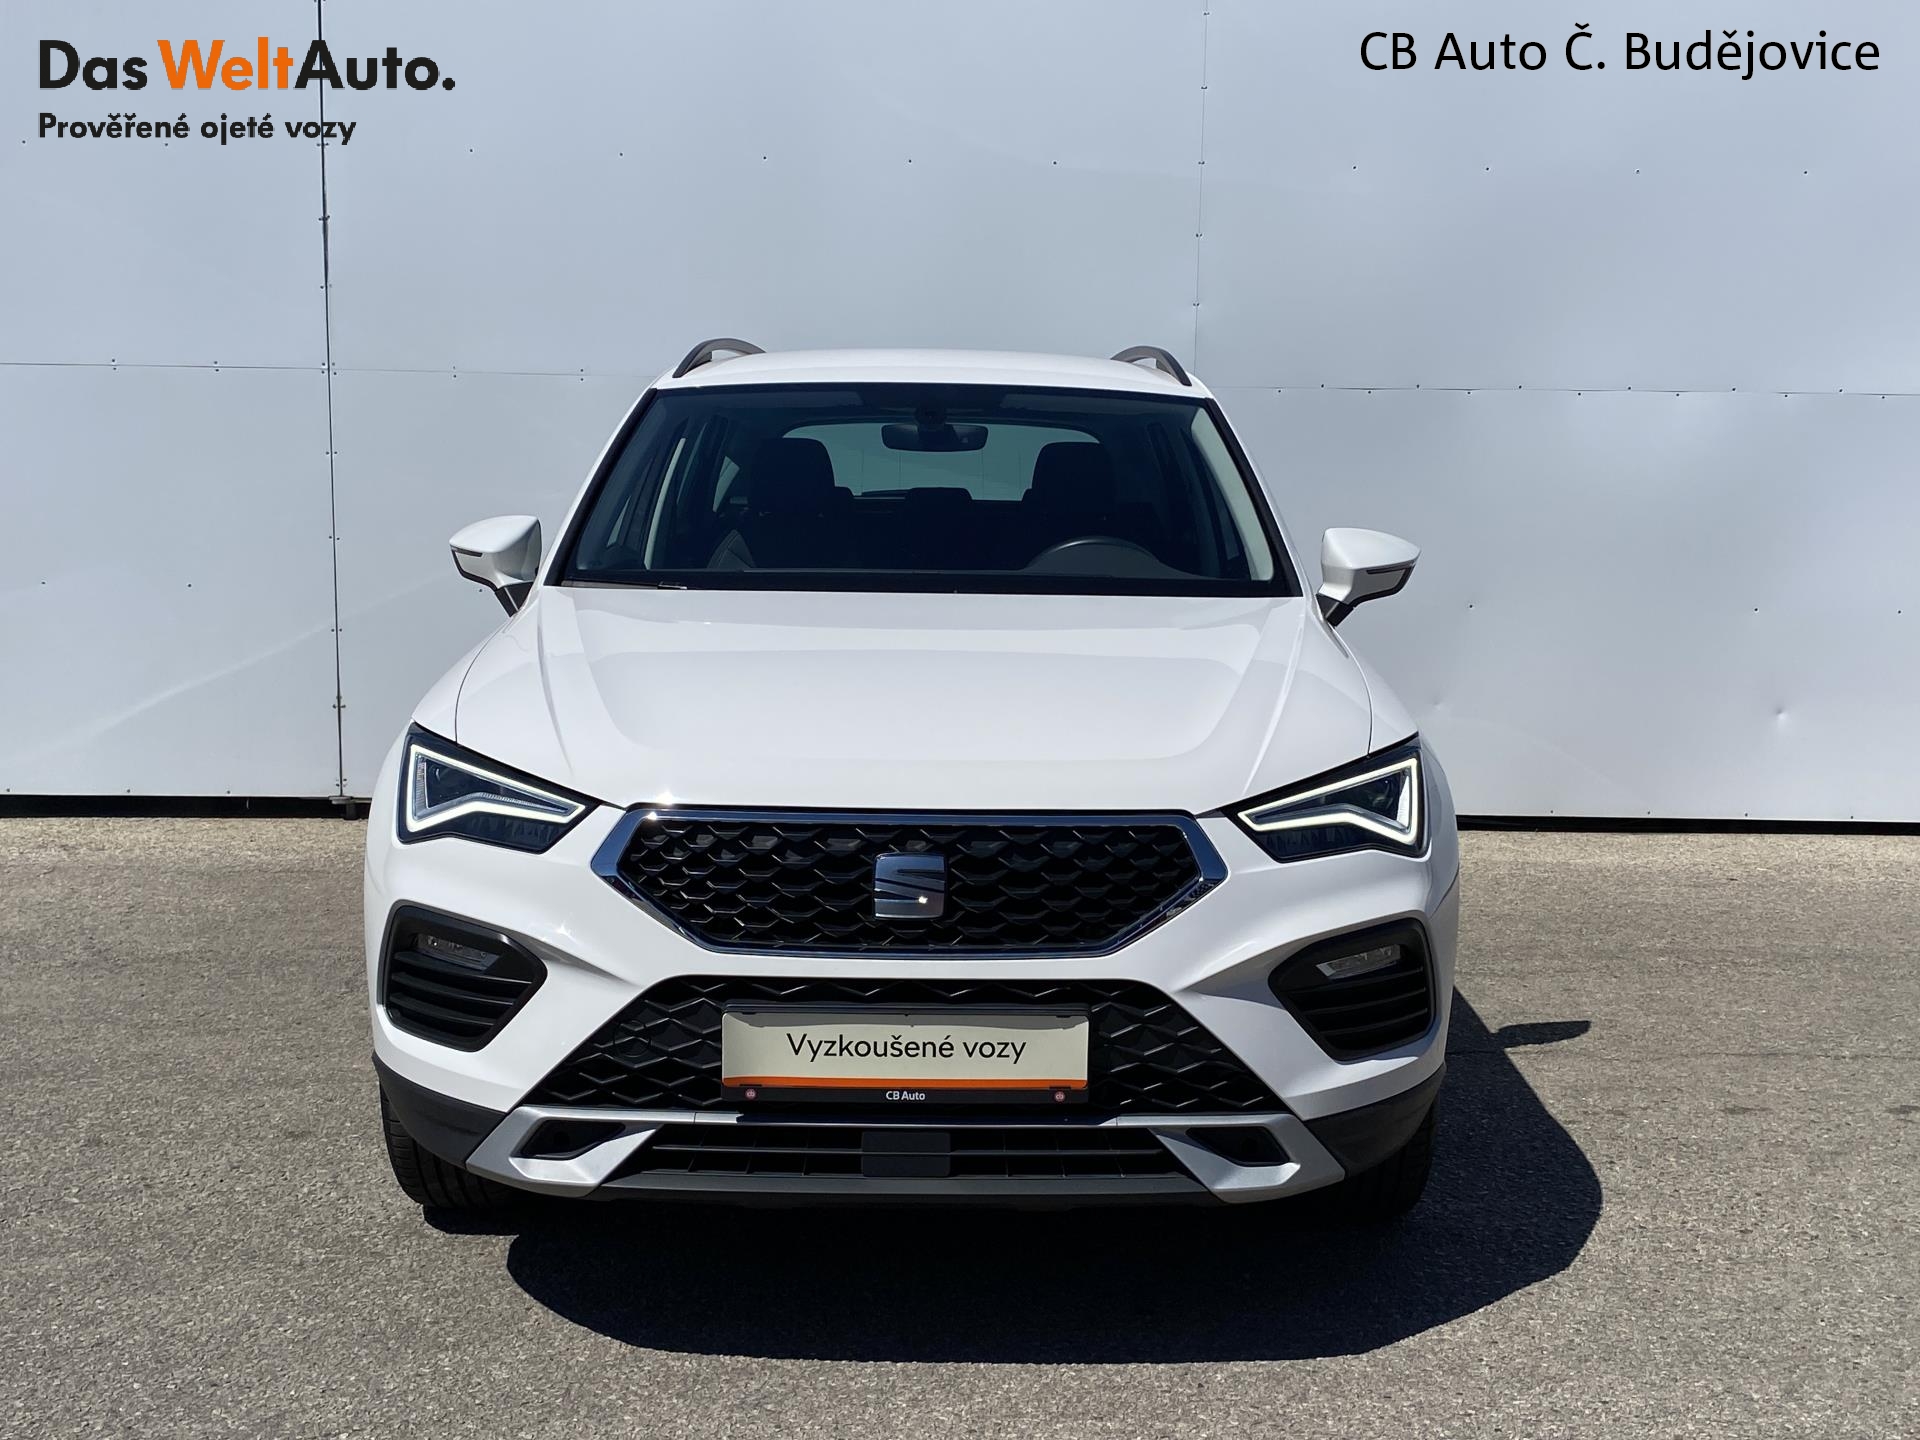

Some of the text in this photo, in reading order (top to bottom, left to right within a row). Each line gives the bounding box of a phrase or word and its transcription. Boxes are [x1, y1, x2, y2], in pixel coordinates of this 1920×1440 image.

[786, 1033, 1027, 1065] Vyzkoušené vozy
[885, 1090, 926, 1101] CB Auto
